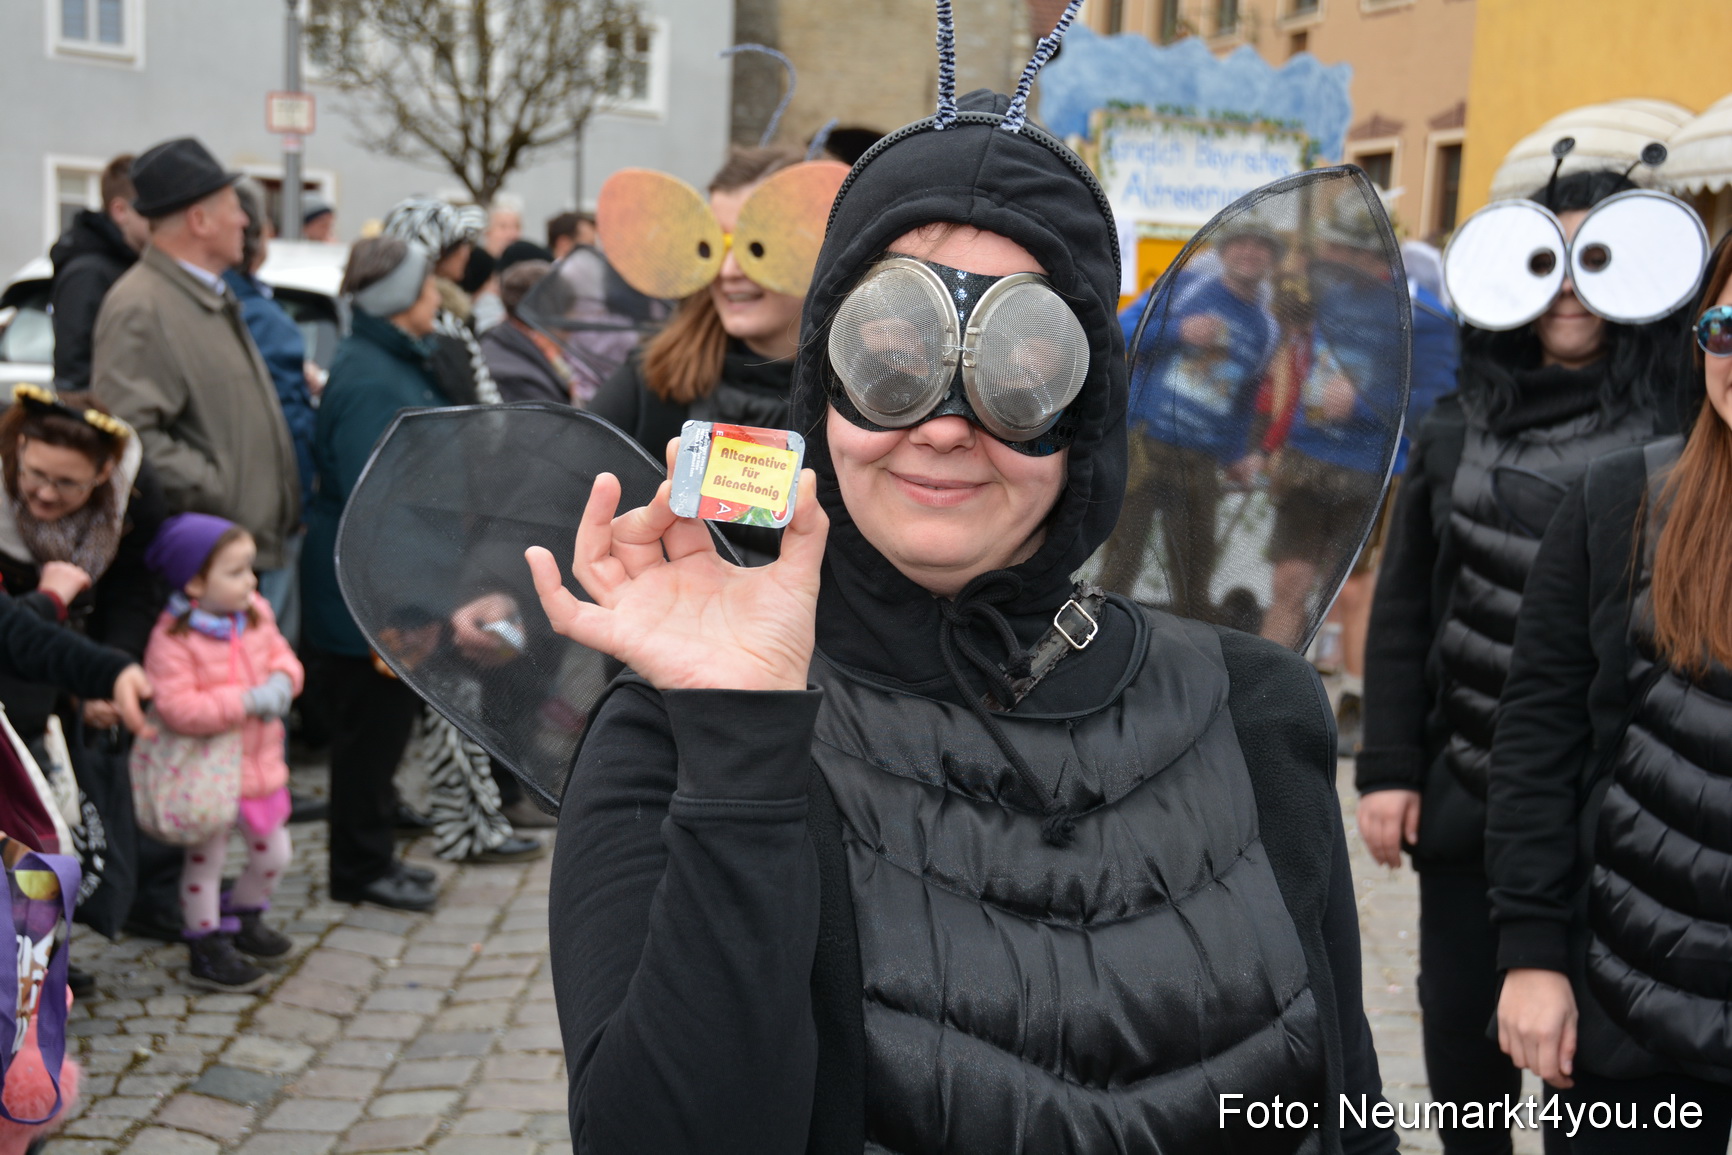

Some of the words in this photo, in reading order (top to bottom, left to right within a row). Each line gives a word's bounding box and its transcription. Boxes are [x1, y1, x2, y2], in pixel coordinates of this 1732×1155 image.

[720, 447, 788, 471] Alternative
[741, 466, 760, 480] für
[713, 474, 780, 501] Bienehonig
